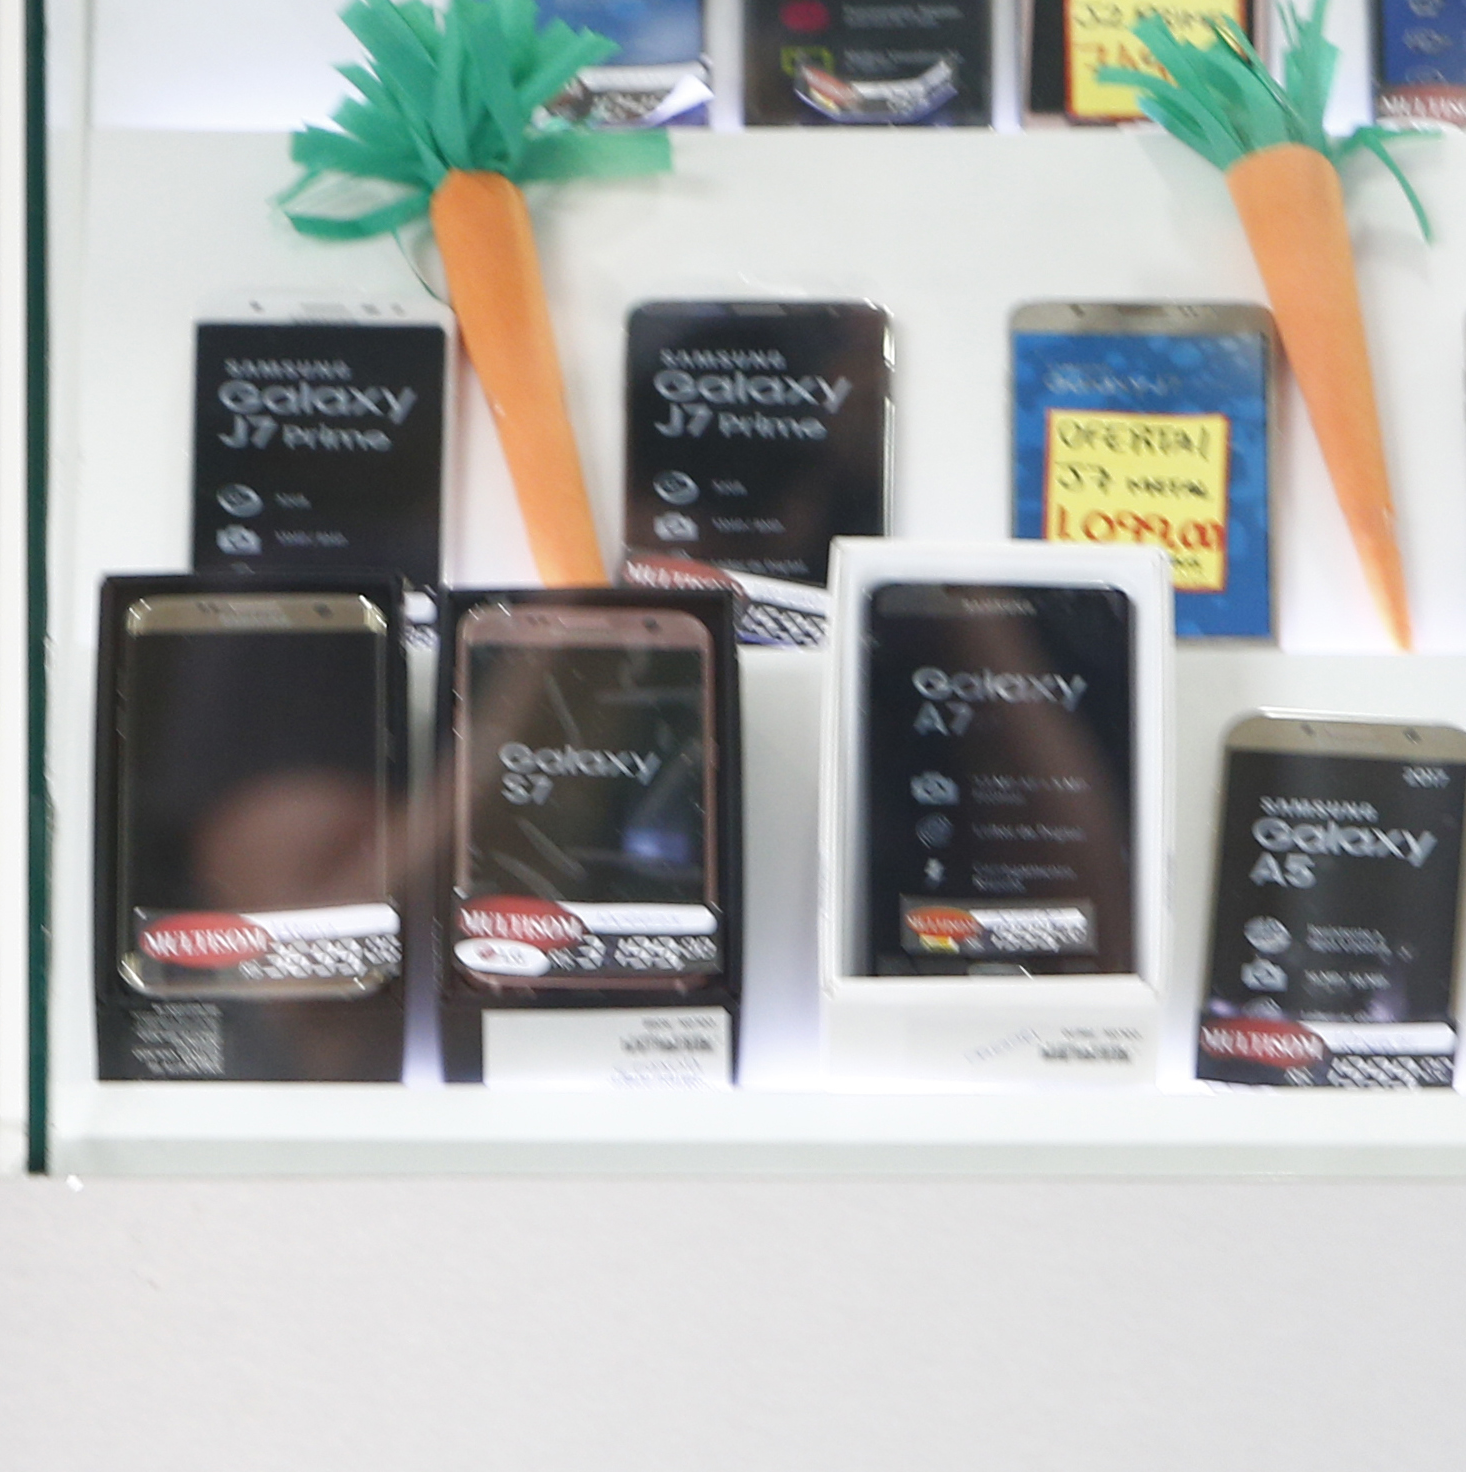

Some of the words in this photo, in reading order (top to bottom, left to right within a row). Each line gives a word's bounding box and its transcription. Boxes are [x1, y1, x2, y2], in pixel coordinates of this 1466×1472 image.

[223, 357, 353, 381] SAMSUNG
[659, 348, 789, 371] SAMSUNG
[217, 379, 418, 426] Galaxy
[652, 369, 854, 415] Galaxy
[217, 413, 279, 450] J7
[281, 422, 393, 453] Prime
[653, 402, 715, 439] J7
[718, 411, 829, 441] Prime
[911, 664, 1088, 714] Galaxy
[912, 701, 973, 738] A7
[497, 740, 661, 787] Galaxy
[1259, 795, 1380, 825] SAMSUNG
[1250, 815, 1439, 869] Galaxy
[1249, 851, 1318, 890] A5
[142, 925, 268, 960] MULTISOM
[460, 906, 585, 943] MULTISOM
[1200, 1024, 1324, 1061] MULTISOM
